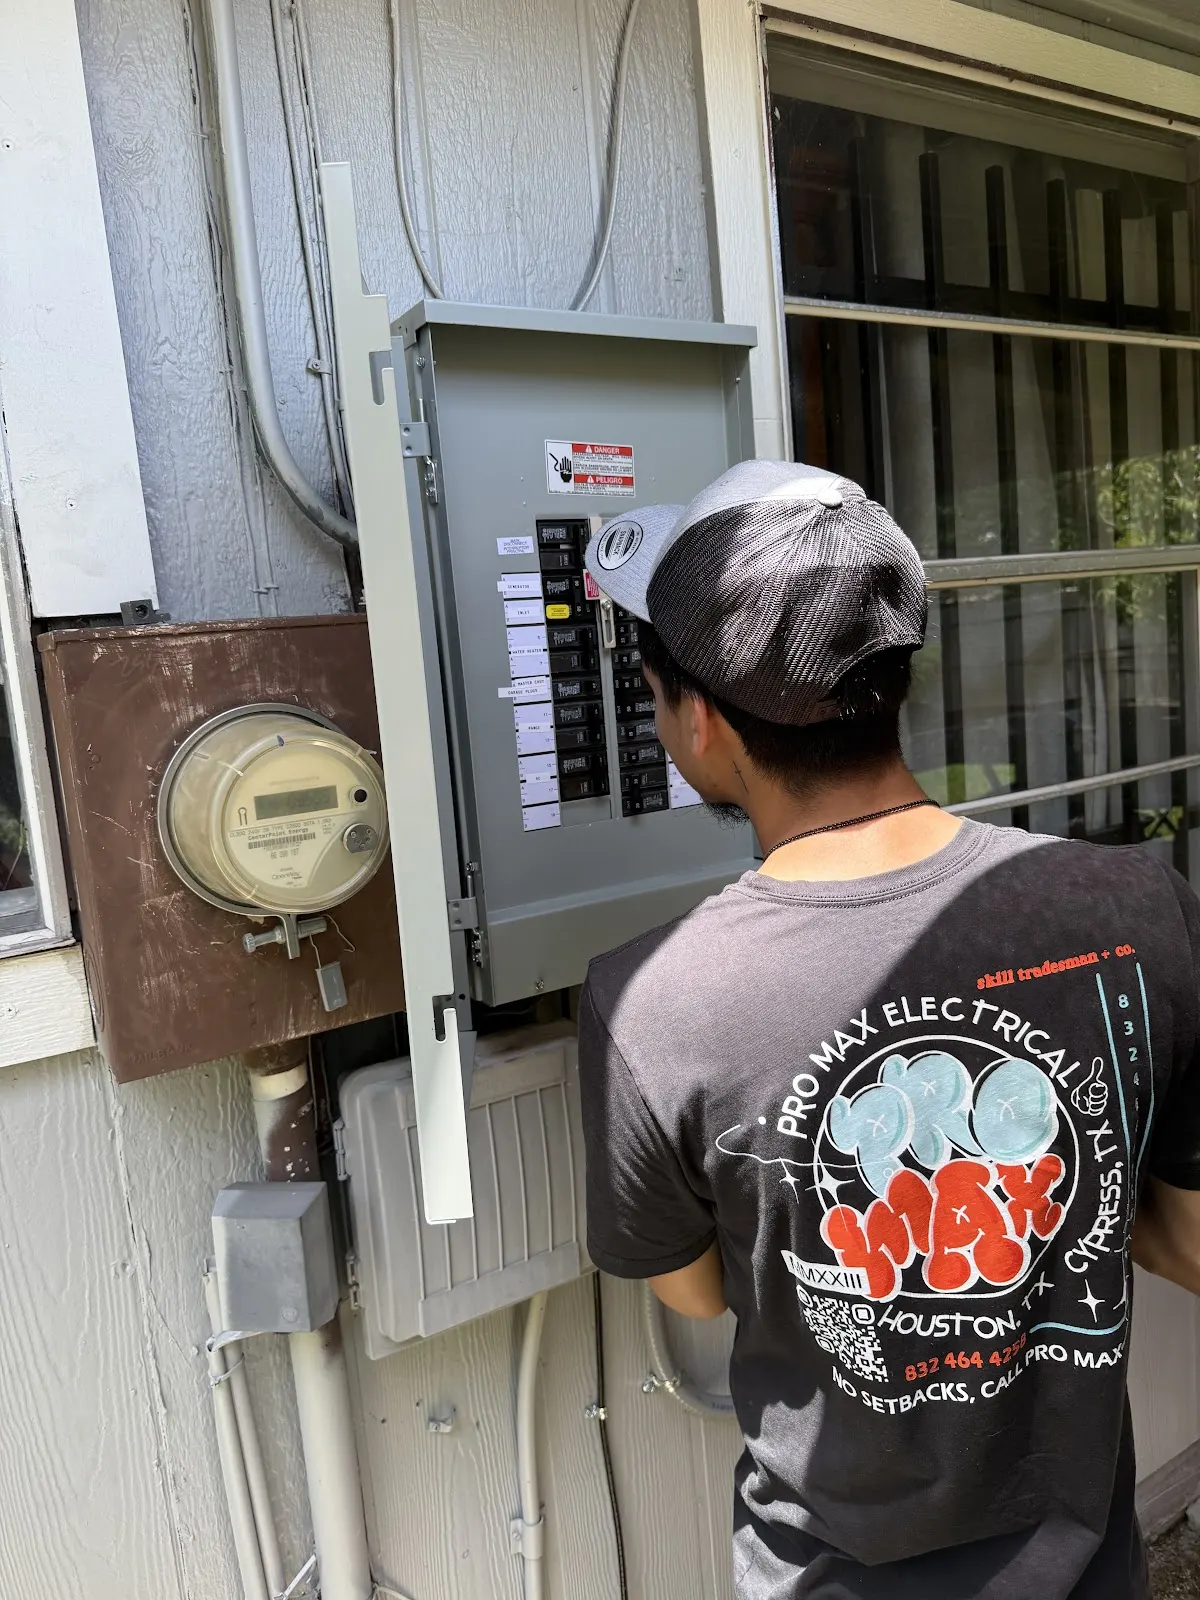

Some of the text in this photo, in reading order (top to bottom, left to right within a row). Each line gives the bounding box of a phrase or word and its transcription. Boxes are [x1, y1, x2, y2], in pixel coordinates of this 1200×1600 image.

[594, 446, 620, 455] DANGER
[595, 476, 623, 485] PELIGRO
[612, 530, 627, 556] SNAPBACK
[247, 827, 309, 841] CenterPoint Energy
[977, 969, 1015, 990] skill
[1017, 951, 1099, 982] tradesman
[1115, 943, 1136, 957] co.
[777, 996, 1081, 1140] PRO MAX ELECTRICAL
[1064, 1119, 1124, 1274] CYPRESS, TX
[788, 1255, 863, 1289] MMXXIII
[1021, 1271, 1055, 1311] TX
[904, 1332, 1027, 1382] 832 464 4258
[832, 1366, 858, 1398] NO
[860, 1382, 976, 1415] SETBACKS,
[980, 1362, 1023, 1398] CALL
[1025, 1344, 1068, 1367] PRO
